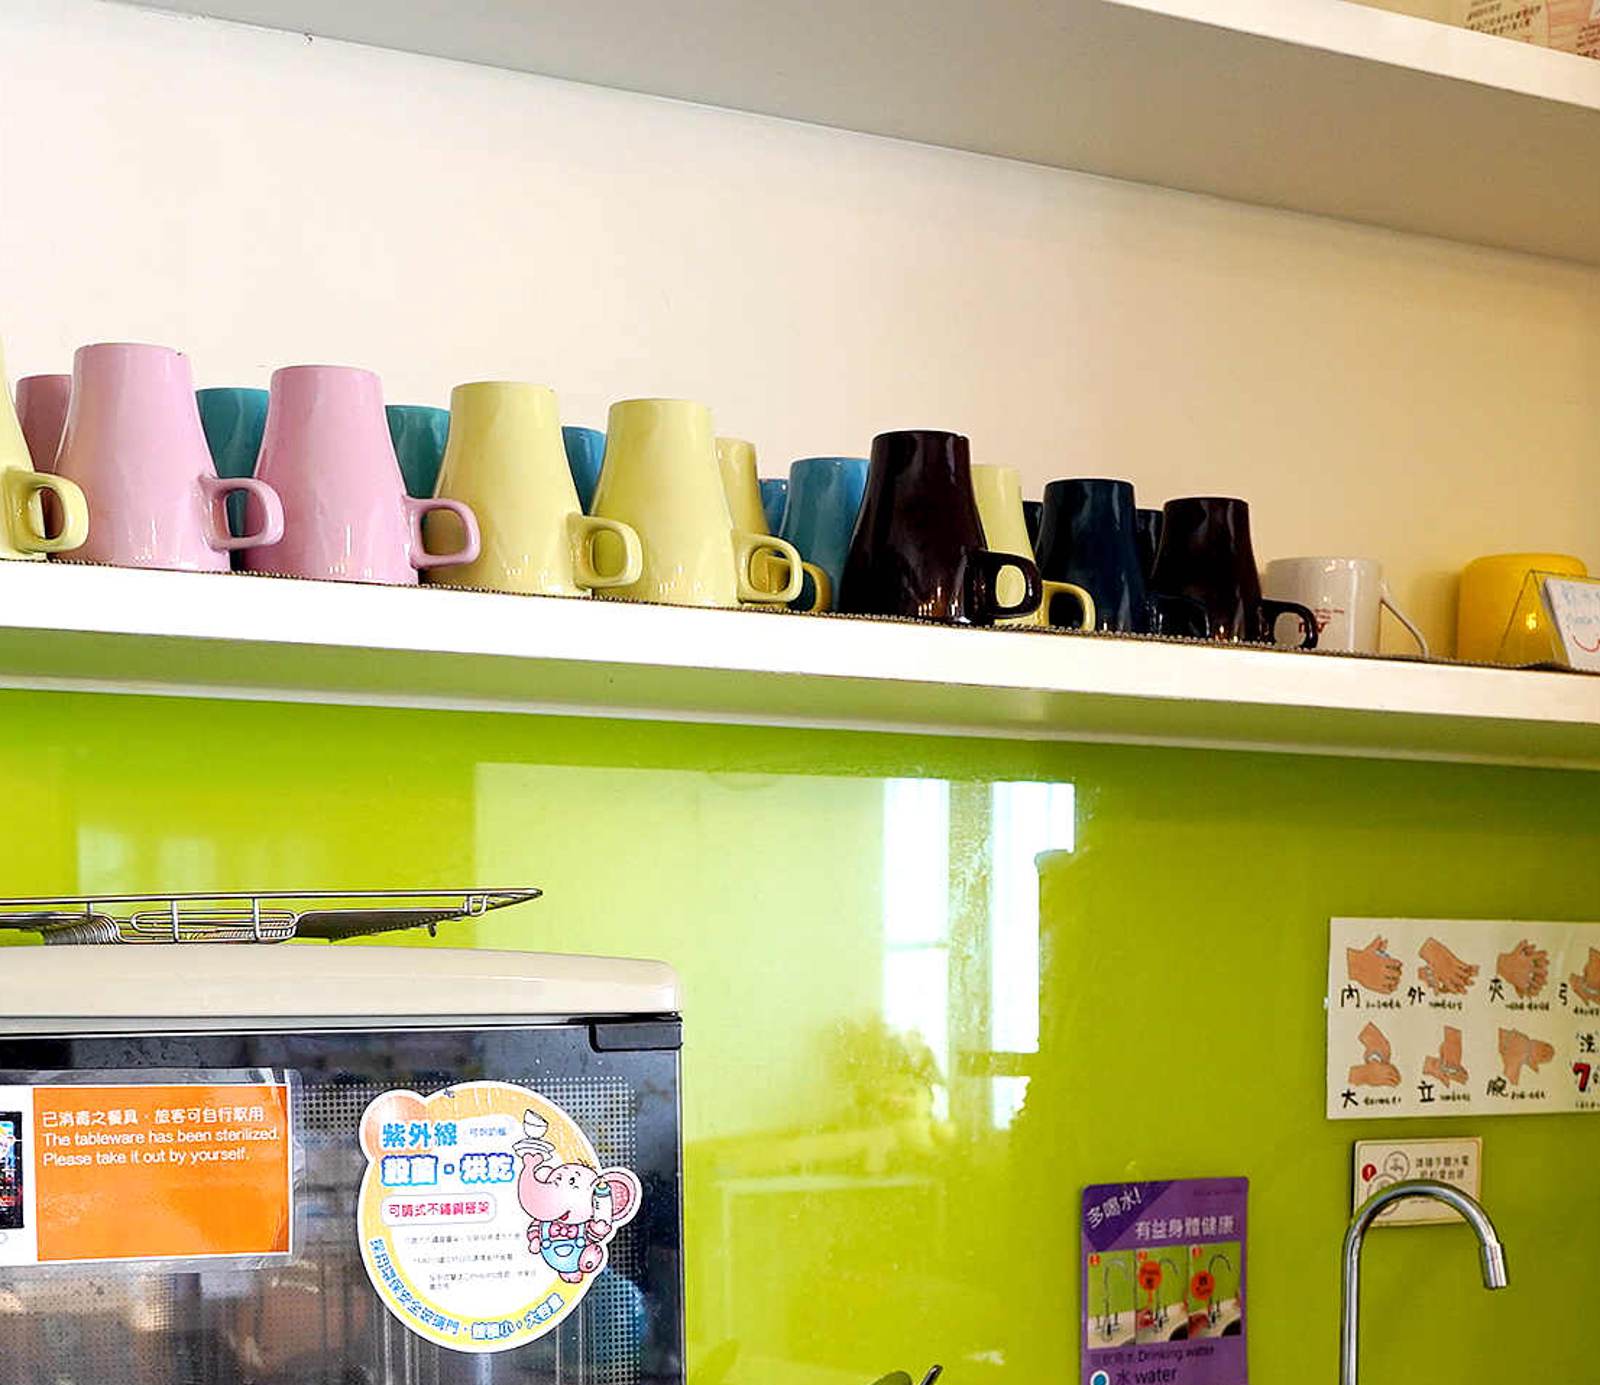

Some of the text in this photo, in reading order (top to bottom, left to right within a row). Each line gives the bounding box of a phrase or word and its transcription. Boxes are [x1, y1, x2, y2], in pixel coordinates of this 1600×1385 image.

[1408, 985, 1426, 1006] 外
[1573, 1062, 1591, 1092] 7
[1341, 1088, 1359, 1108] 大
[1417, 1080, 1435, 1103] 立
[42, 1124, 280, 1147] The tableware has been sterilized.
[382, 1122, 458, 1148] 紫外線
[43, 1146, 250, 1167] Please take it out by yourself.
[1135, 1215, 1235, 1241] 有益身體健康
[1135, 1369, 1178, 1384] water
